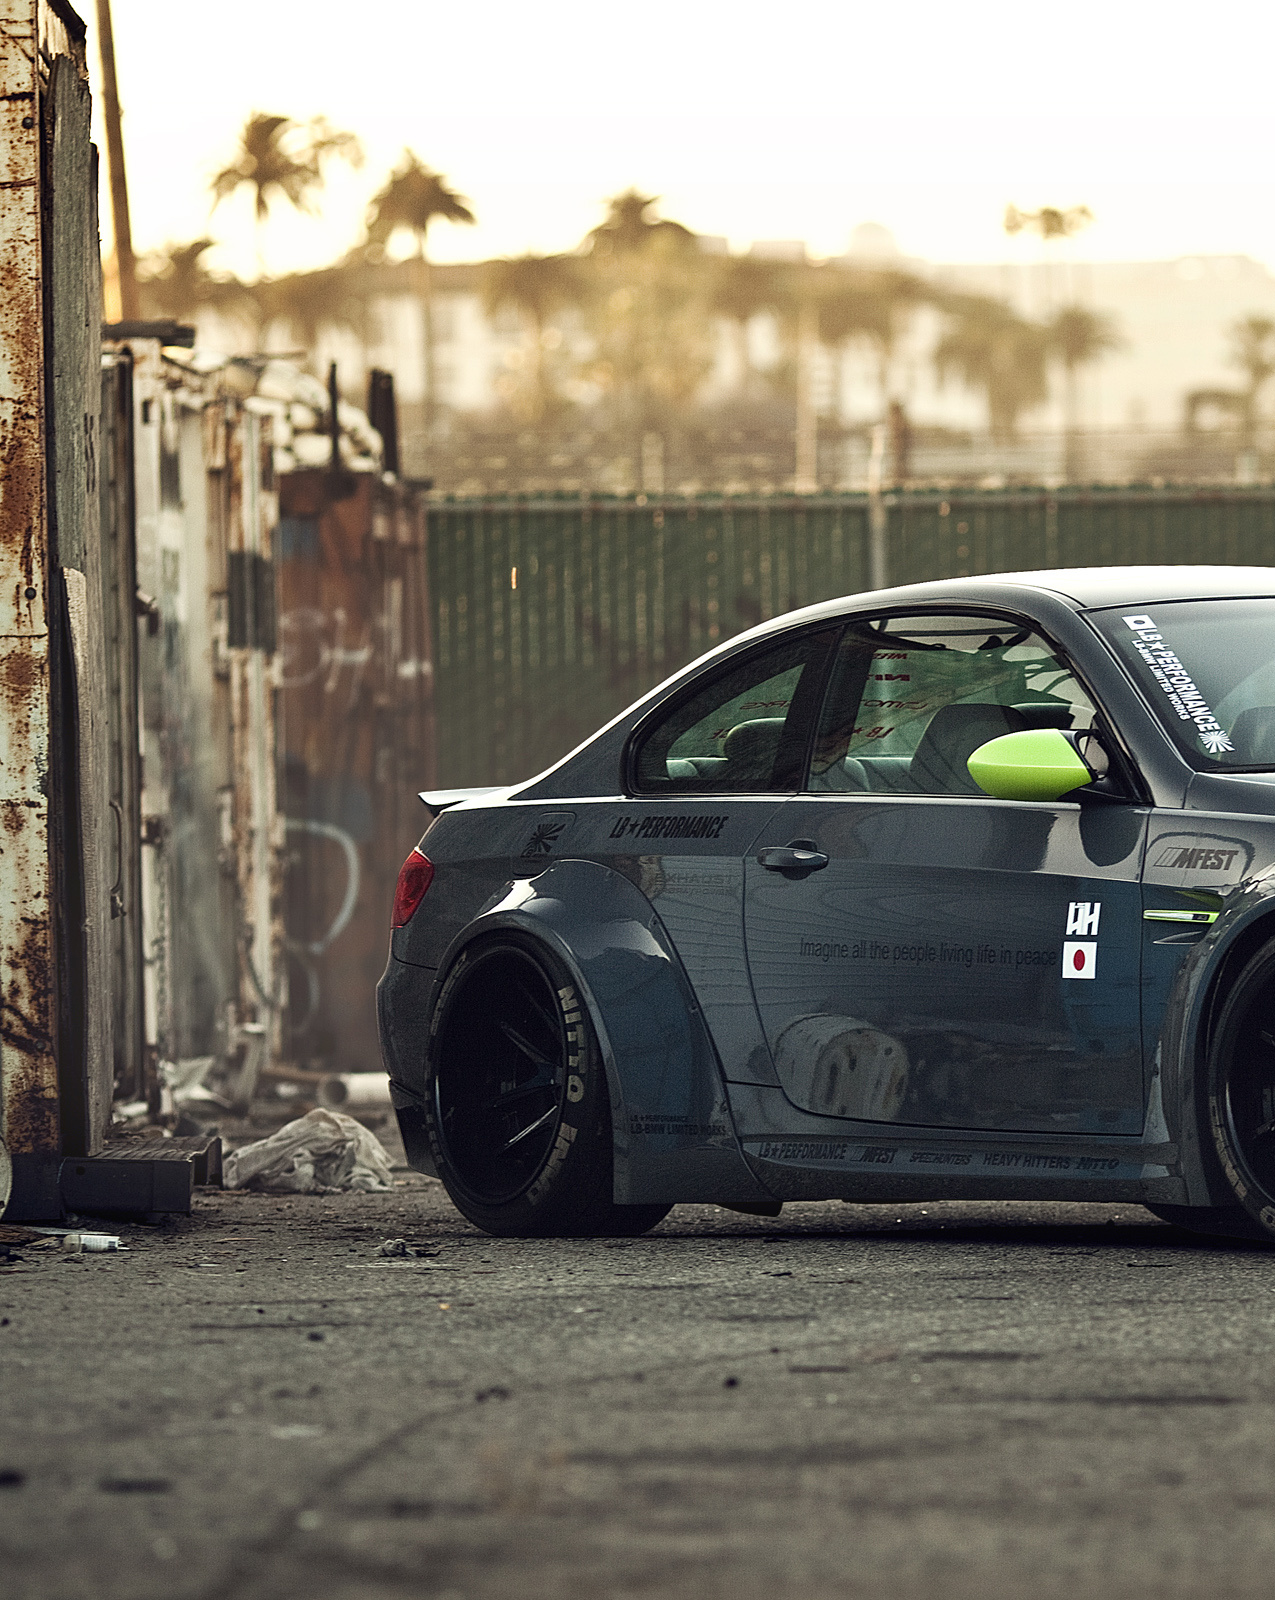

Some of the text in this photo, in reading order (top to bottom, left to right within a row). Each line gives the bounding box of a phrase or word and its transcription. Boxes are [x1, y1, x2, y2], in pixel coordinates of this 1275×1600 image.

[1149, 665, 1173, 693] LIMITED
[1167, 693, 1190, 720] WORKS
[1152, 651, 1221, 732] PERFORMANCE
[634, 816, 729, 838] PERFORMANCE
[800, 938, 1058, 970] Imagine all the people living life in peace
[557, 986, 586, 1103] NITTO
[778, 1143, 848, 1160] PERFORMANCE
[983, 1152, 1020, 1167] HEAVY
[1024, 1155, 1070, 1169] HITTERS
